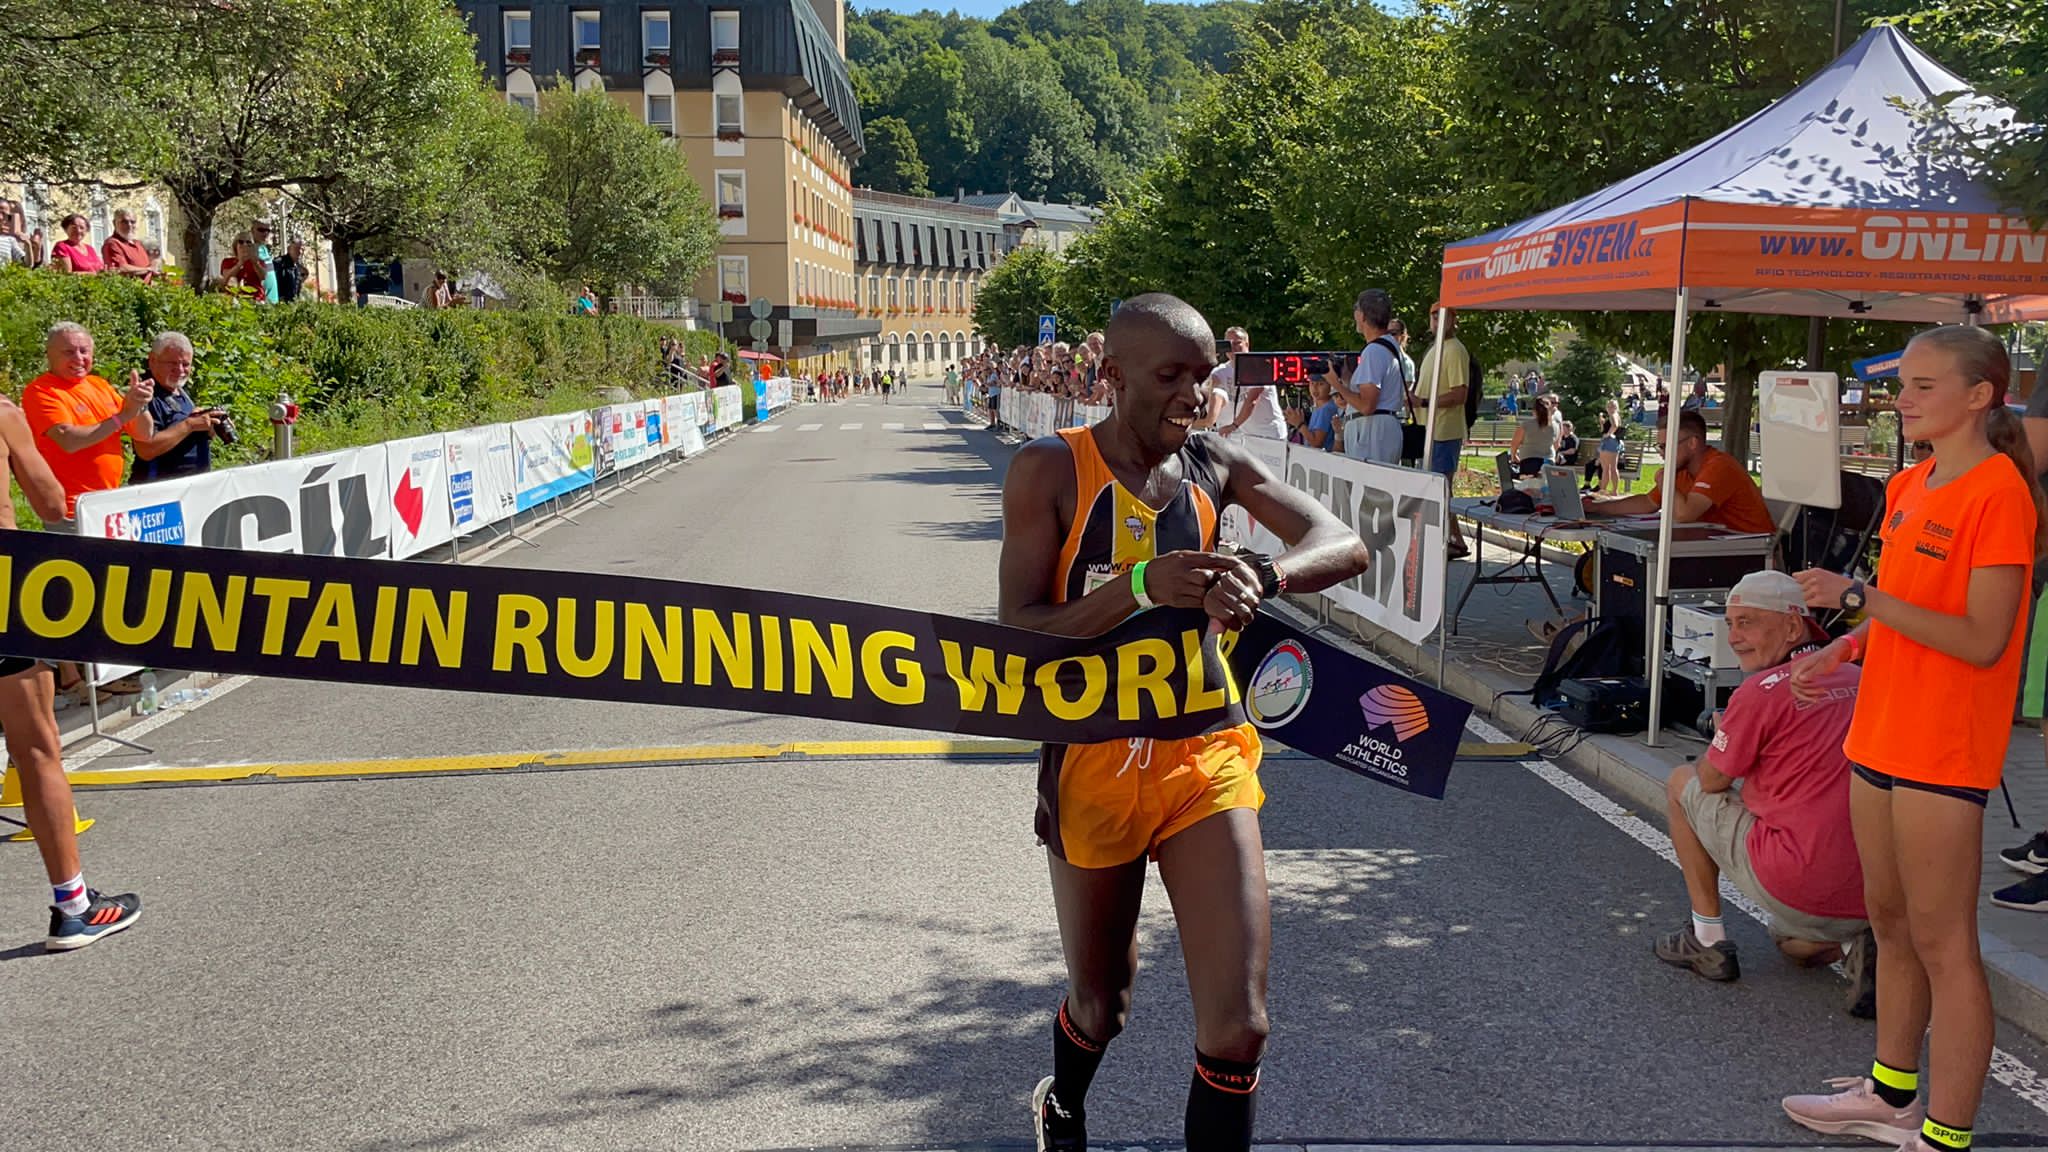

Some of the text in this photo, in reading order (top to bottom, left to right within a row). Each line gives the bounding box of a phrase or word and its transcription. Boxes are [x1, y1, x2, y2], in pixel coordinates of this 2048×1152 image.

[1788, 269, 1872, 279] TECHNOLOGY
[1879, 271, 1970, 281] REGISTRATION
[0, 555, 468, 668] OUNTAIN
[492, 594, 926, 705] RUNNING
[1343, 743, 1408, 777] ATHLETICS
[1359, 734, 1402, 760] WORLD
[1932, 1126, 1969, 1143] SPORT
